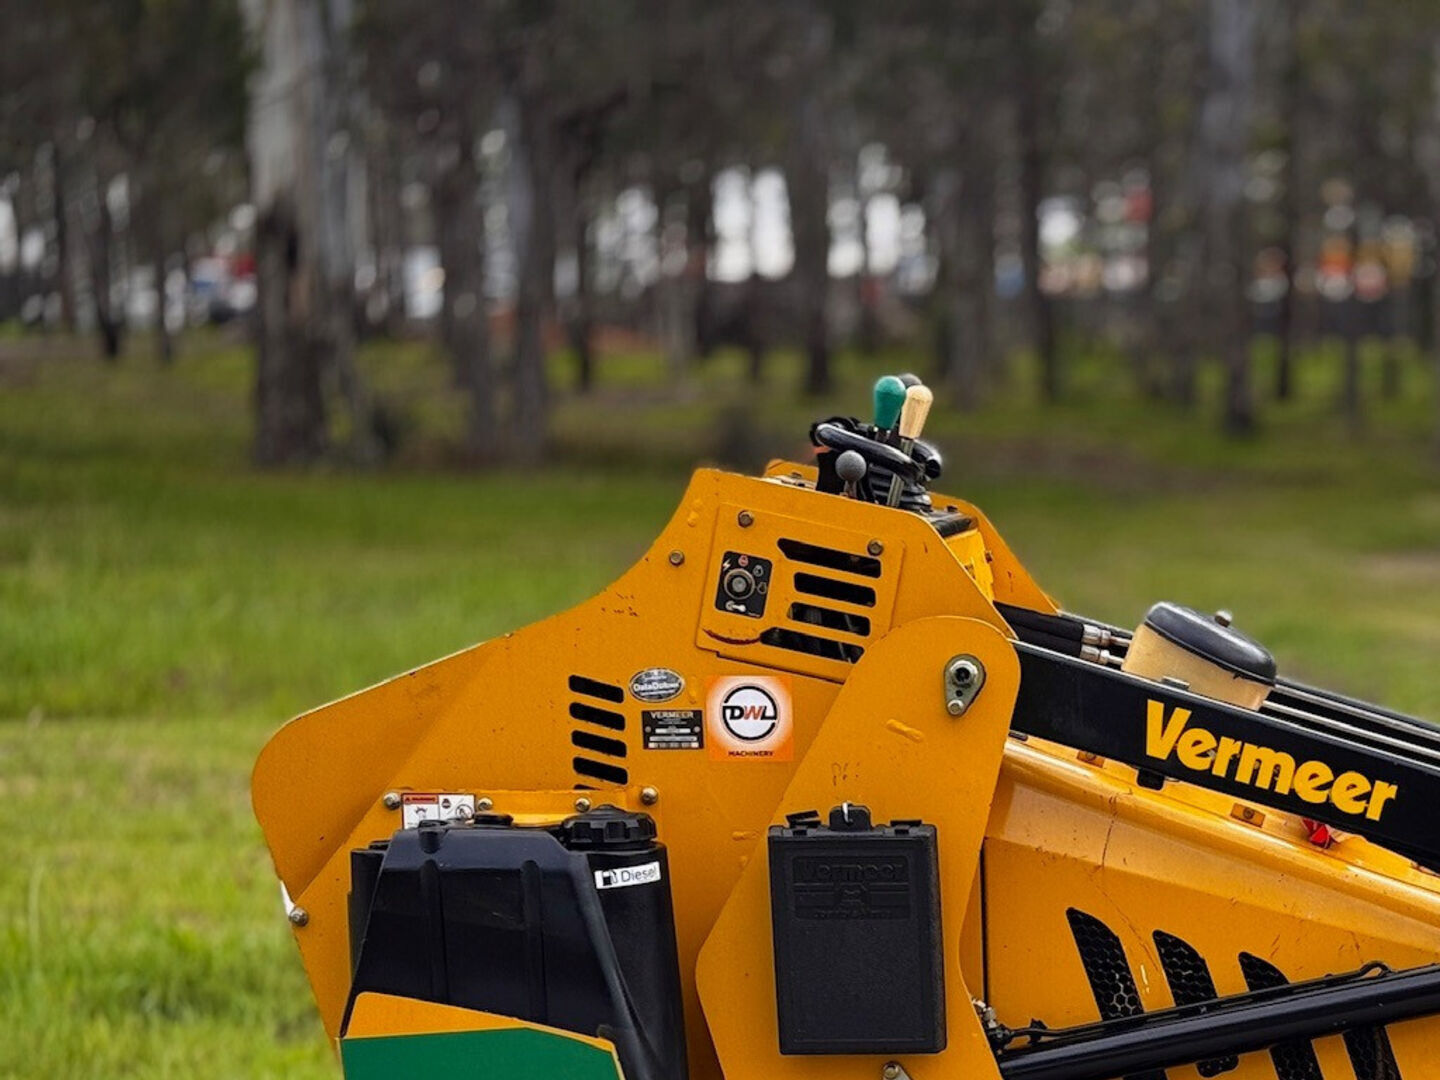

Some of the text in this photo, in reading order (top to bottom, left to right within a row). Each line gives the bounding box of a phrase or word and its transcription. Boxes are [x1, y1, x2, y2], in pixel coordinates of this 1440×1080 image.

[723, 705, 777, 720] DWL
[1146, 699, 1398, 821] Vermeer
[620, 865, 657, 882] Diesel
